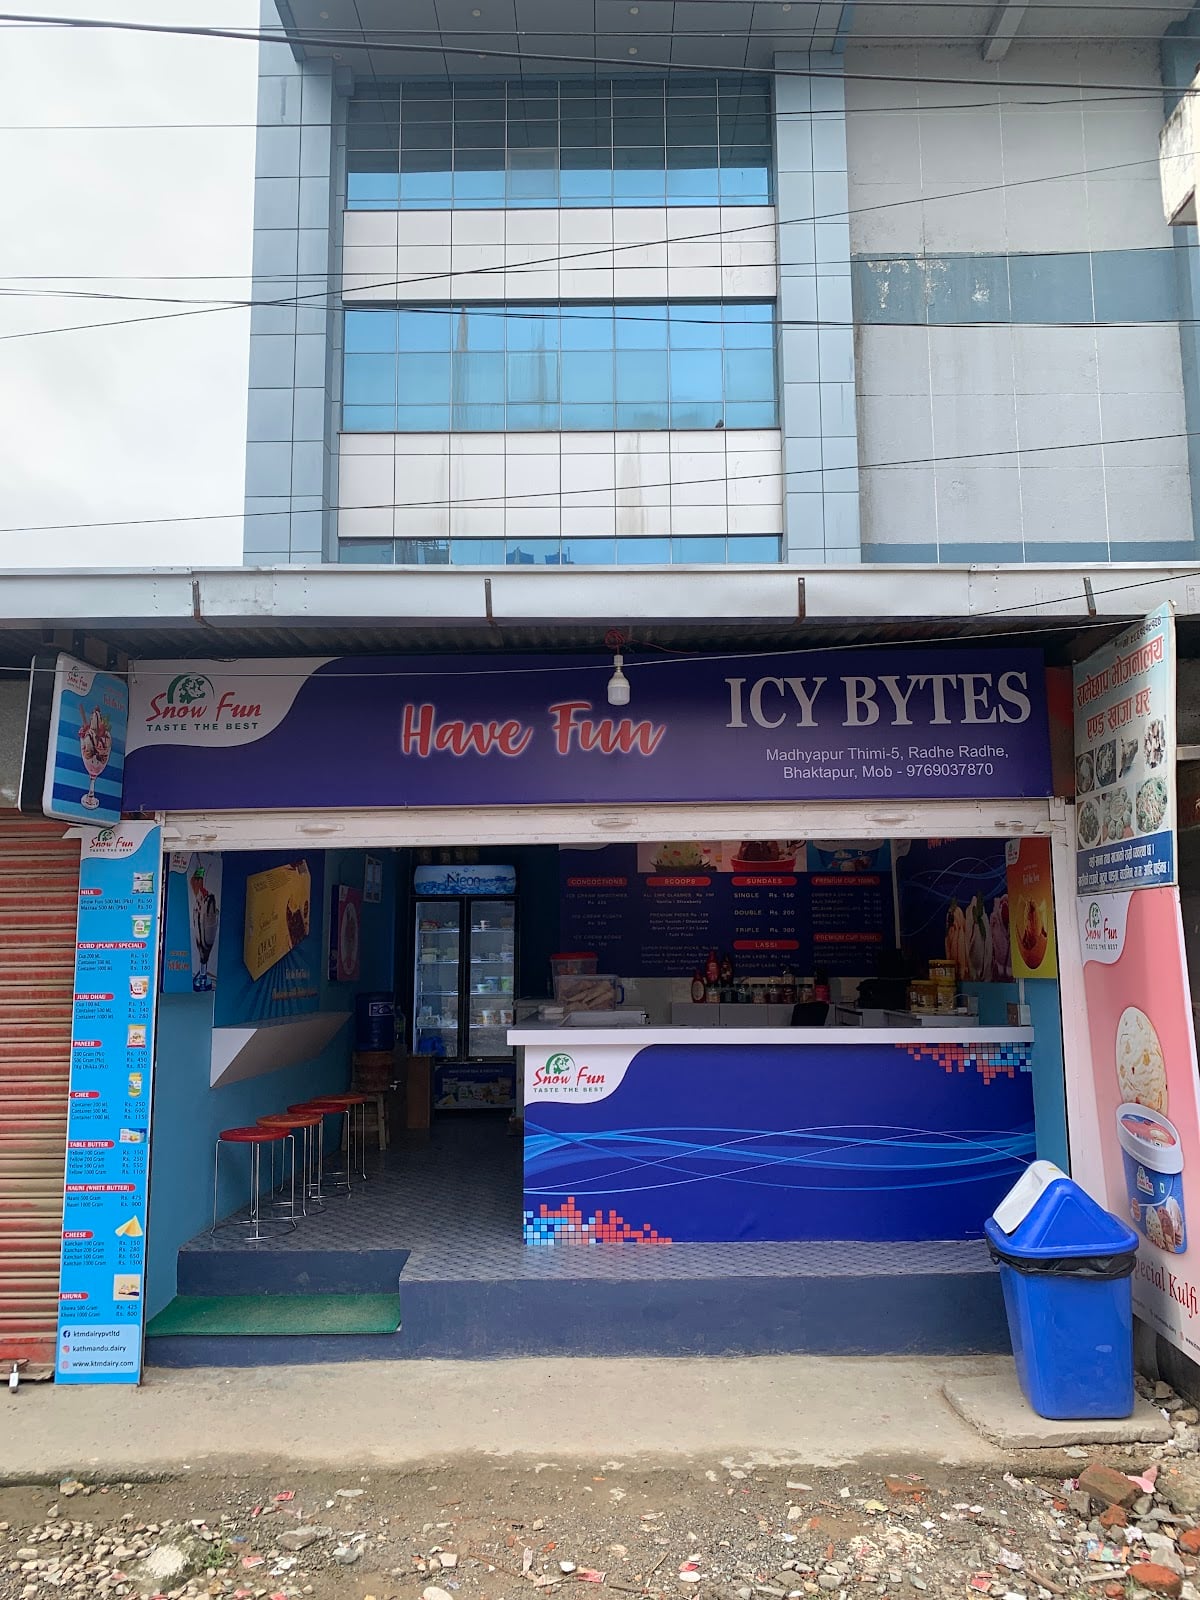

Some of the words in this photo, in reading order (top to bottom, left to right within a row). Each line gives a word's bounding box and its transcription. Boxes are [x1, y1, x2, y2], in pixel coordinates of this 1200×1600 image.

[1112, 636, 1164, 687] भोजनालय
[146, 693, 207, 721] Snow
[216, 692, 261, 721] Fun
[724, 677, 827, 728] ICY
[840, 671, 1031, 726] BYTES
[1108, 697, 1132, 730] खाजा
[1136, 687, 1151, 715] घर
[226, 722, 259, 730] BEST
[402, 703, 534, 758] Have
[548, 701, 666, 755] Fun
[766, 748, 844, 764] Madhyapur
[848, 747, 903, 762] Thimi-5,
[909, 746, 954, 758] Radhe
[958, 746, 1009, 759] Radhe,
[783, 766, 857, 780] Bhaktapur,
[862, 766, 893, 778] Mob
[907, 763, 993, 777] 9769037870
[90, 837, 112, 848] Snow
[116, 837, 133, 848] Fun
[445, 872, 480, 889] Neon
[533, 1067, 571, 1086] Snow
[576, 1067, 606, 1086] Fun
[1134, 1258, 1165, 1291] pecial
[1168, 1272, 1198, 1318] Kulfi
